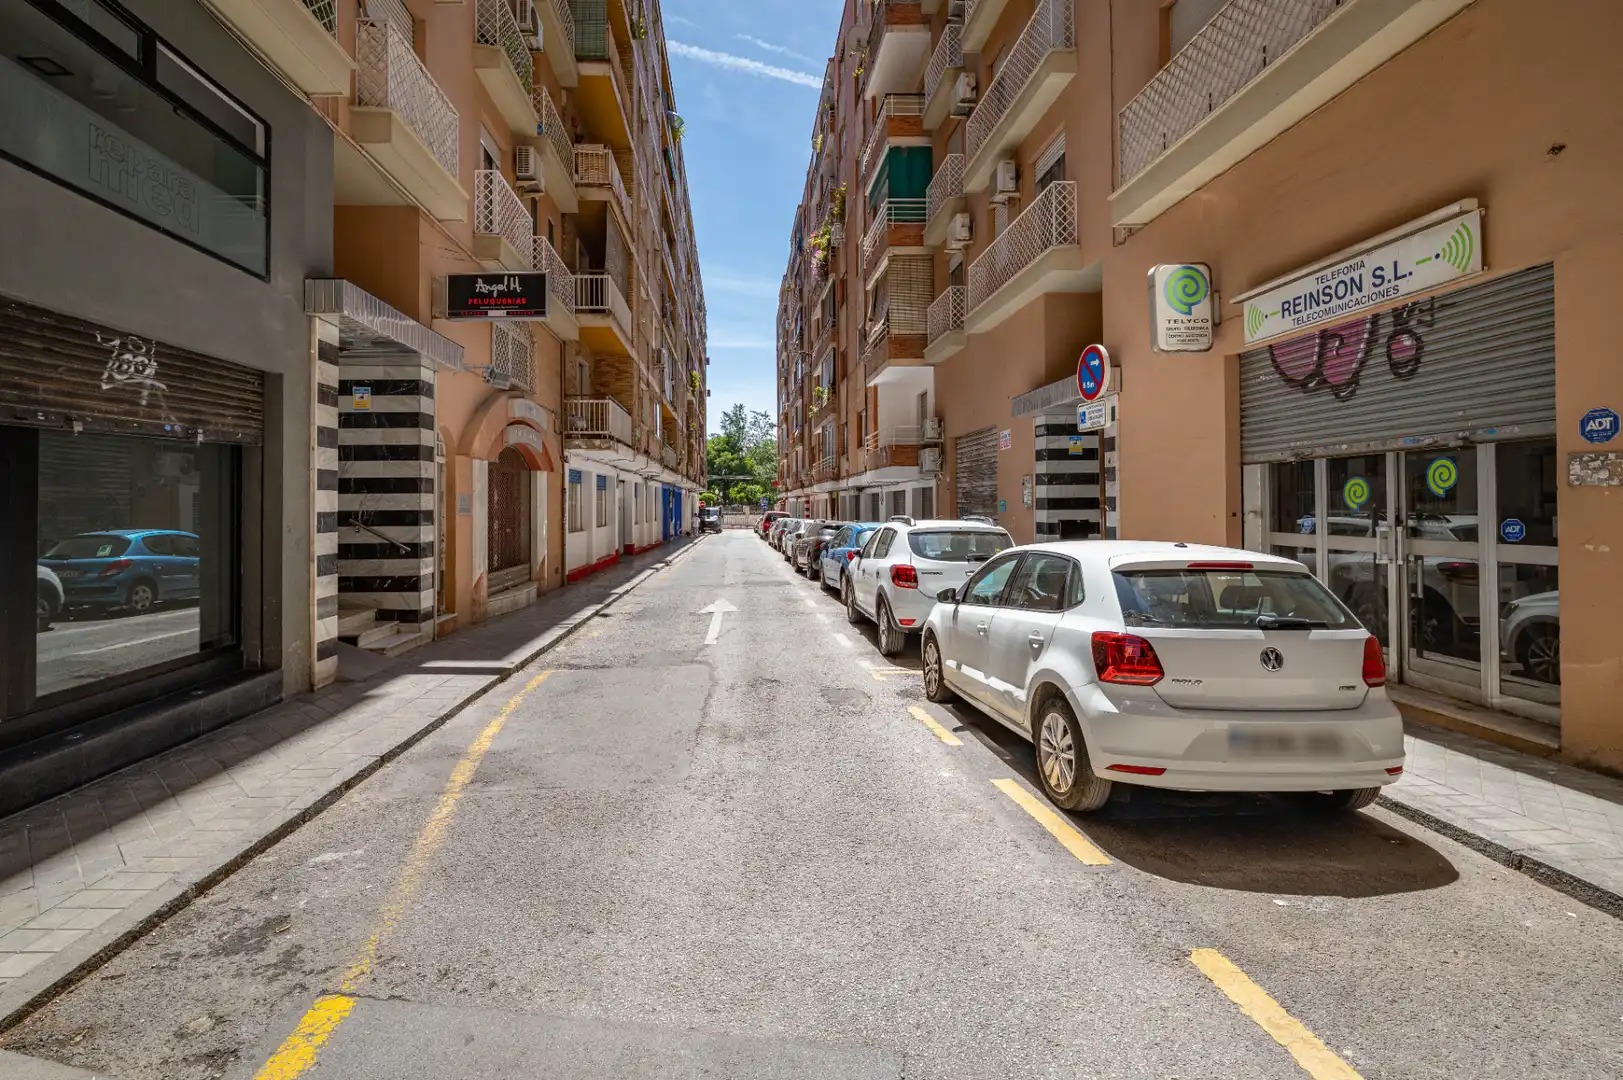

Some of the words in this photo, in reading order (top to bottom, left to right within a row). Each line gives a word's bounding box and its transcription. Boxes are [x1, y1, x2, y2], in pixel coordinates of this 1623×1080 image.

[1315, 260, 1366, 286] TELEFONIA
[475, 275, 508, 298] Angel
[1281, 273, 1364, 319] REINSON
[1371, 260, 1413, 288] S.L.
[468, 297, 527, 305] PELUQUERIAS
[1292, 284, 1400, 326] TELECOMUNICACIONES
[1585, 417, 1614, 431] ADT
[1504, 525, 1521, 533] ADT
[1171, 678, 1203, 687] POLO
